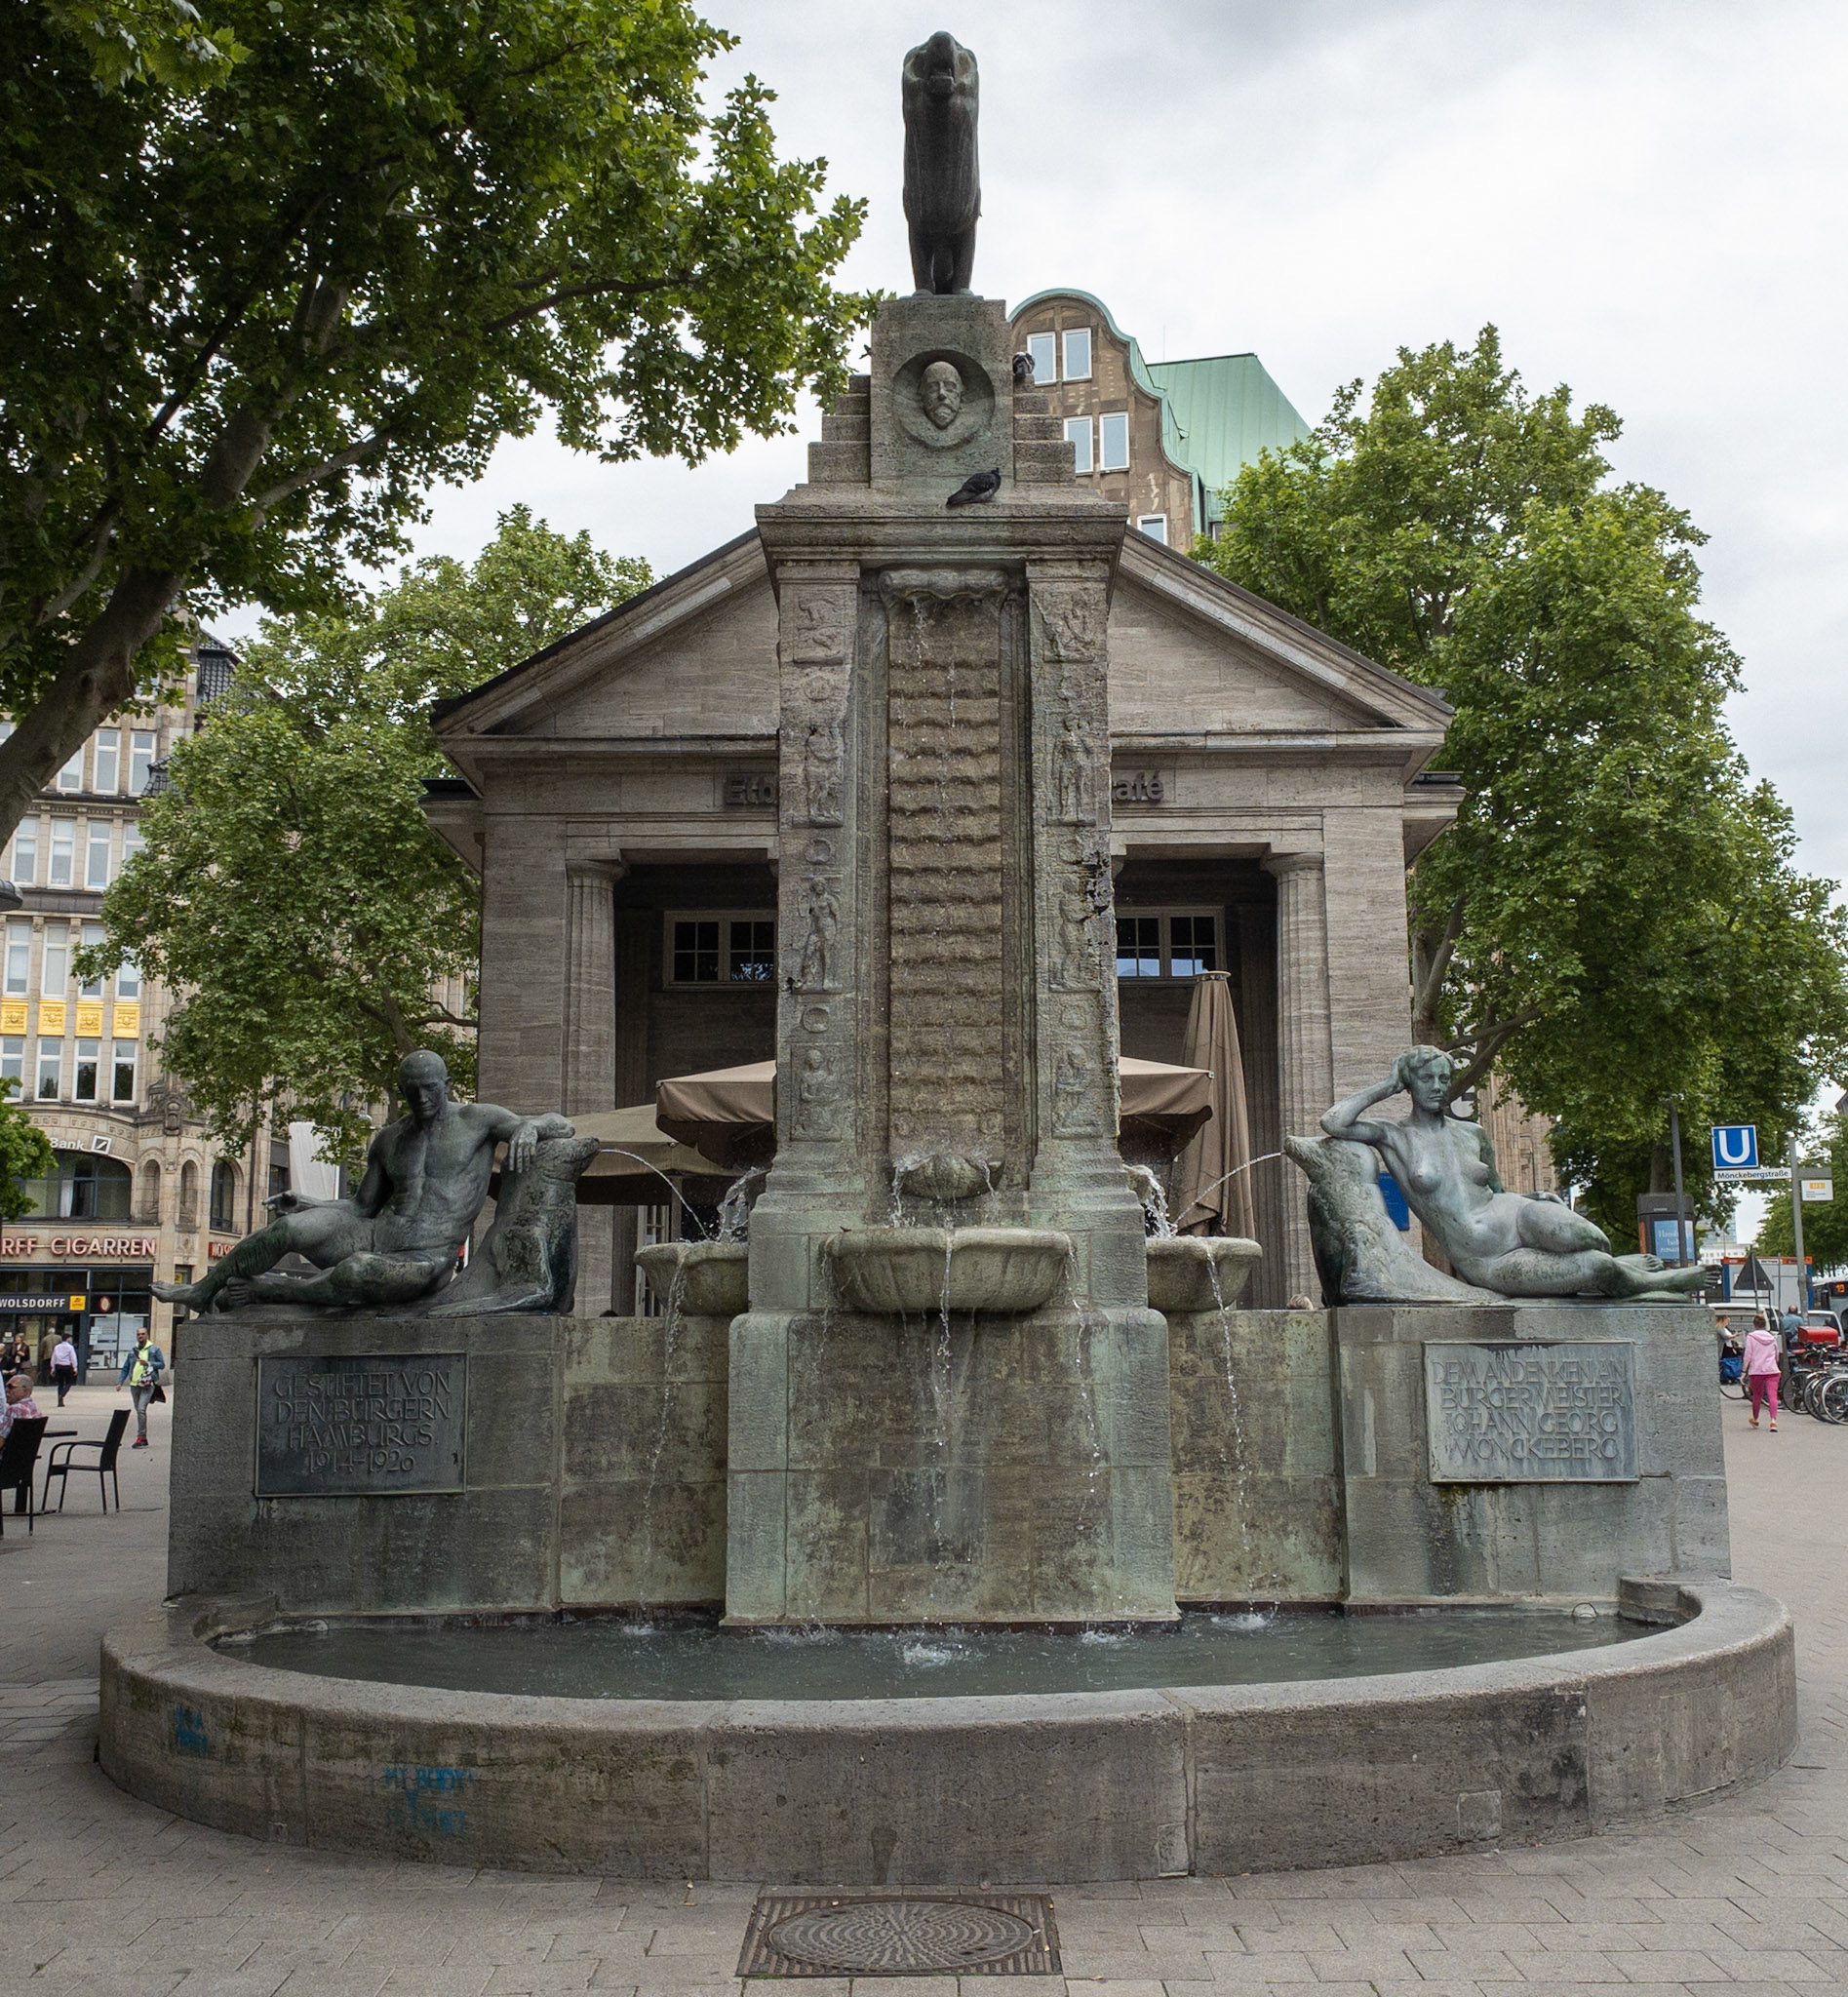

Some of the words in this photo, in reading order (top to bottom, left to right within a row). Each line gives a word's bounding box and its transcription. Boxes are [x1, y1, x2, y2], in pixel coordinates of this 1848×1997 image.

[1112, 769, 1164, 801] afé
[50, 1137, 85, 1151] Bank
[1718, 1128, 1750, 1164] U
[1717, 1170, 1789, 1180] Mönckebergstraße
[51, 1236, 157, 1258] CIGARREN
[275, 1372, 393, 1397] GESTIFTET
[401, 1371, 451, 1394] VON
[1433, 1360, 1482, 1384] DEM
[277, 1399, 326, 1423] DEN
[334, 1396, 450, 1420] BÜRGERN
[1446, 1410, 1531, 1433] JOHANN
[1538, 1410, 1619, 1433] GEORG
